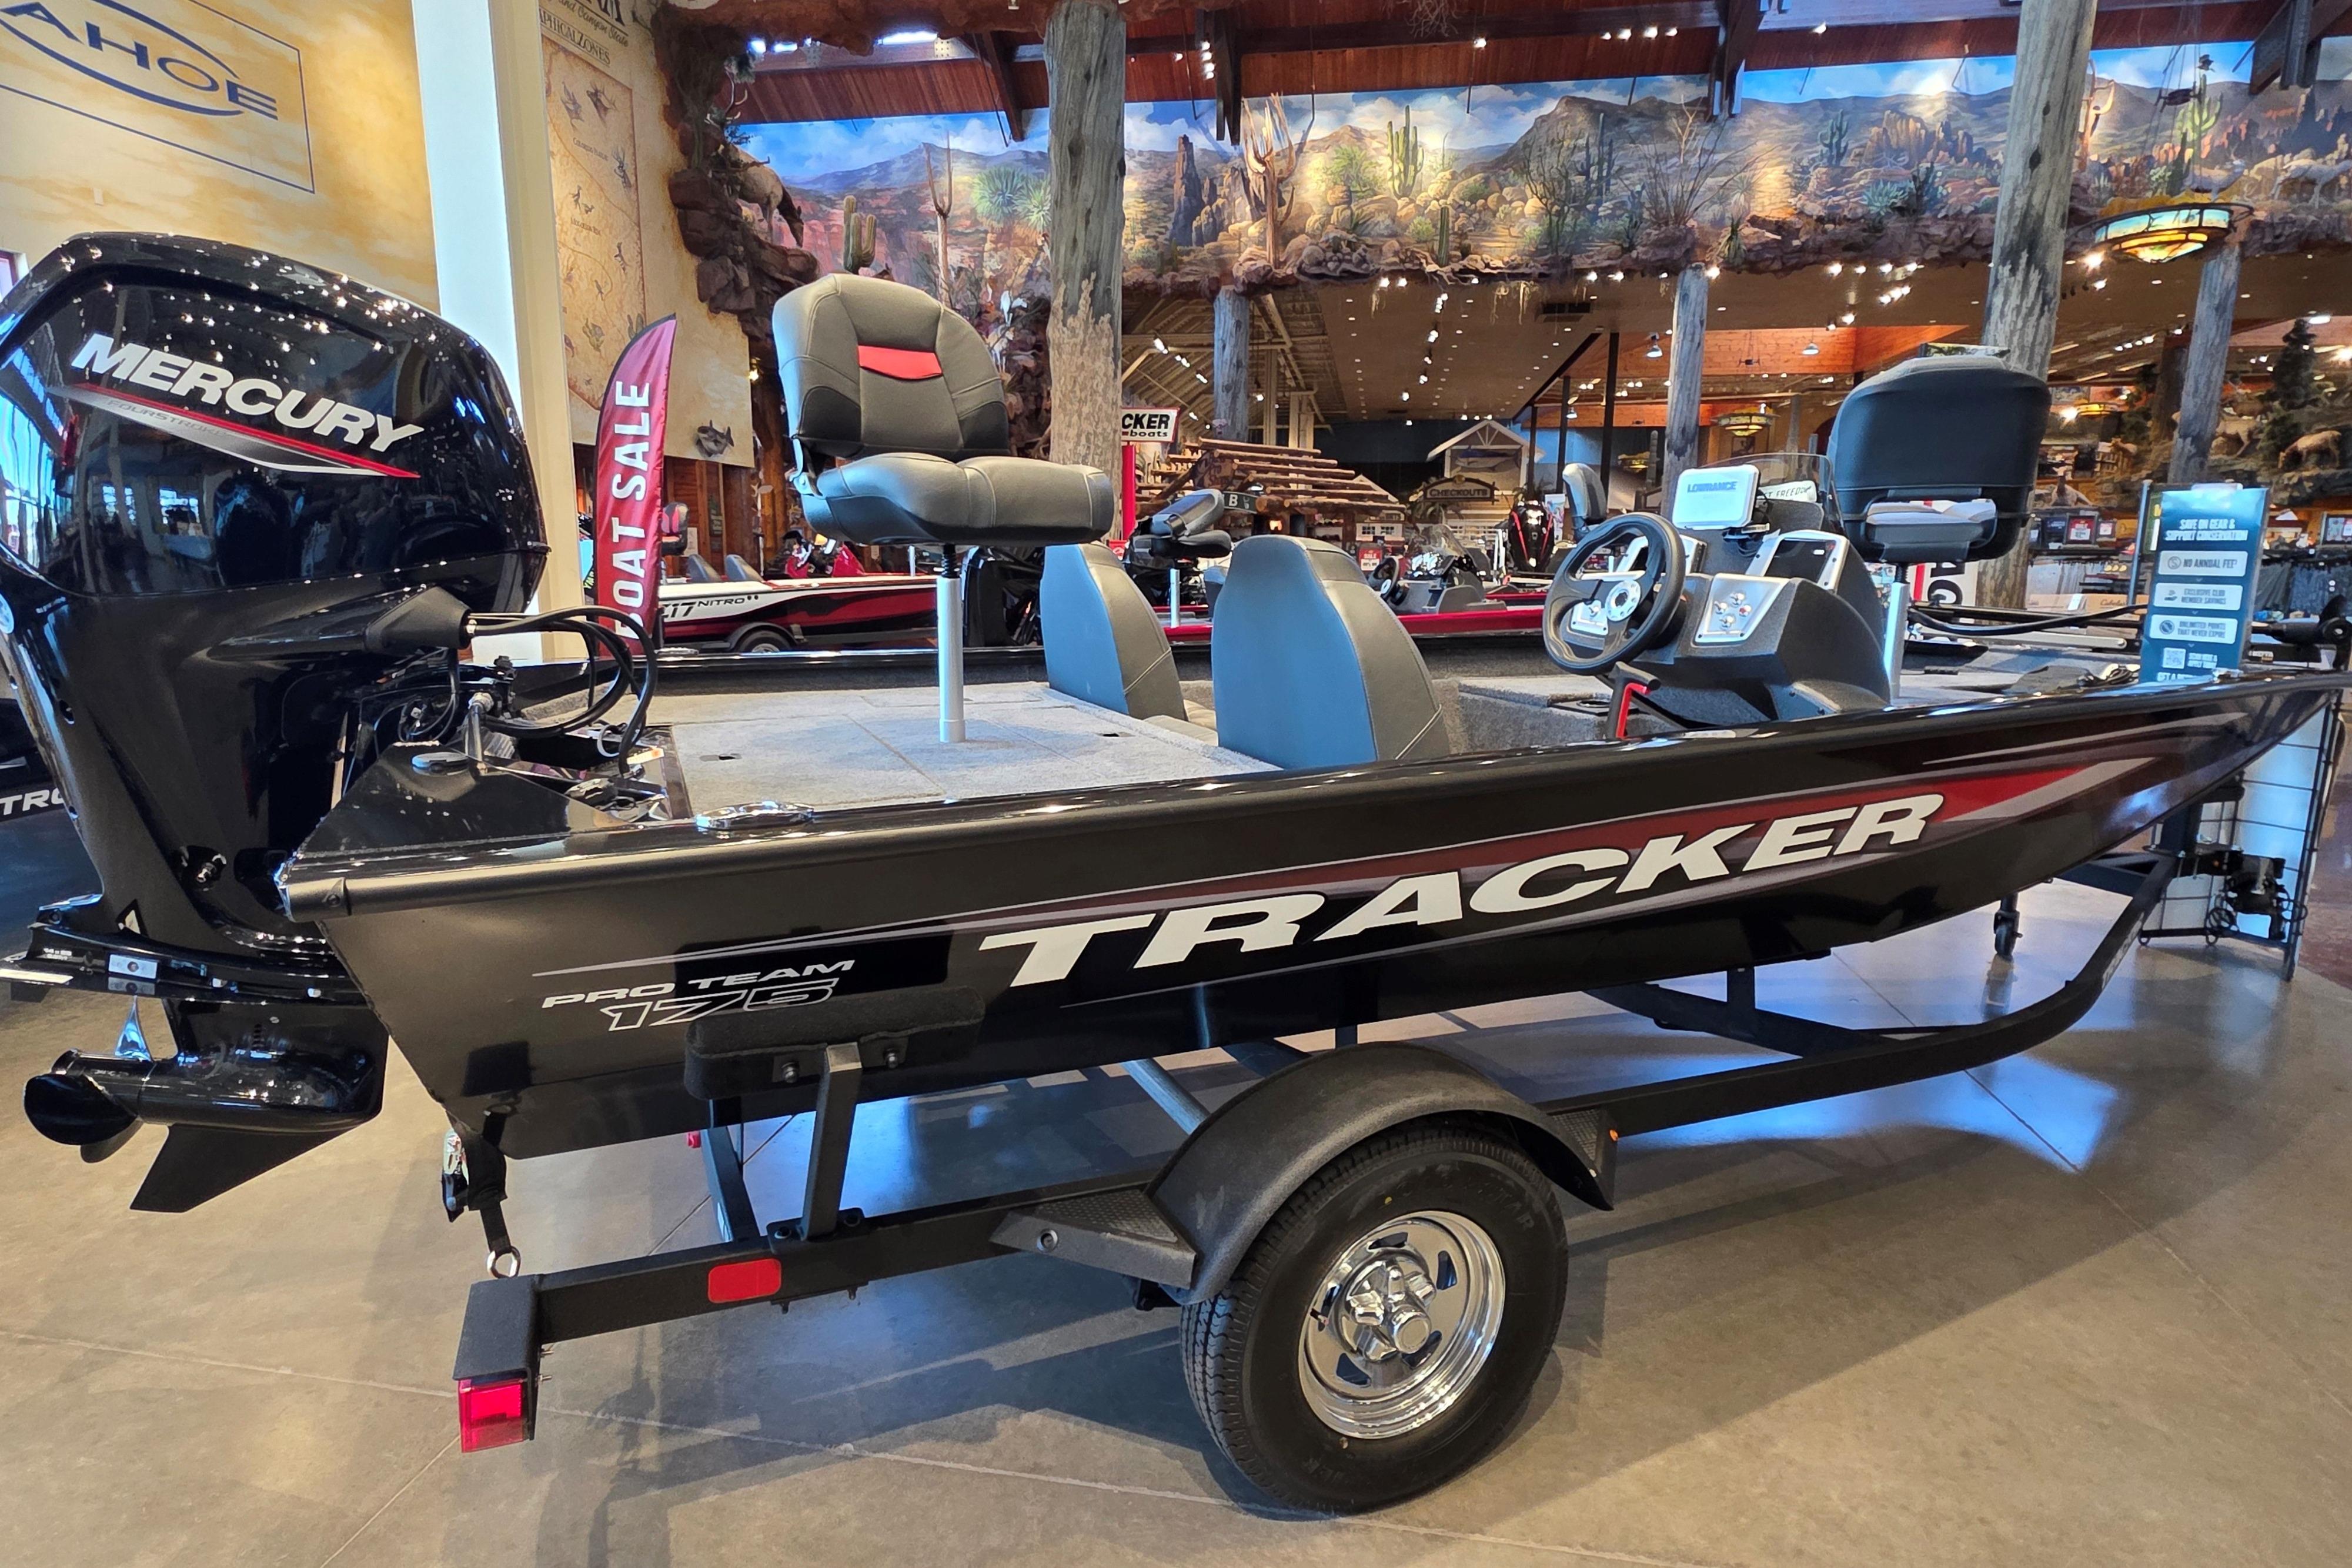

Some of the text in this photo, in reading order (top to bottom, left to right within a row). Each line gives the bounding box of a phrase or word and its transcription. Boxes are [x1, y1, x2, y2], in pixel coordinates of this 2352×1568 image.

[577, 8, 607, 34] Canyon
[608, 25, 629, 47] State
[576, 34, 610, 65] ZONES
[71, 333, 425, 452] MERCURY
[106, 400, 233, 438] FOURSTROKE
[1121, 413, 1170, 429] CKER
[612, 380, 652, 502] SALE
[1688, 481, 1738, 493] LOWRANCE
[2194, 559, 2220, 569] ANNUAL
[697, 598, 745, 607] NITRO
[980, 793, 1945, 989] TRACKER
[542, 960, 856, 1008] PRO TEAM
[600, 978, 840, 1031] 175
